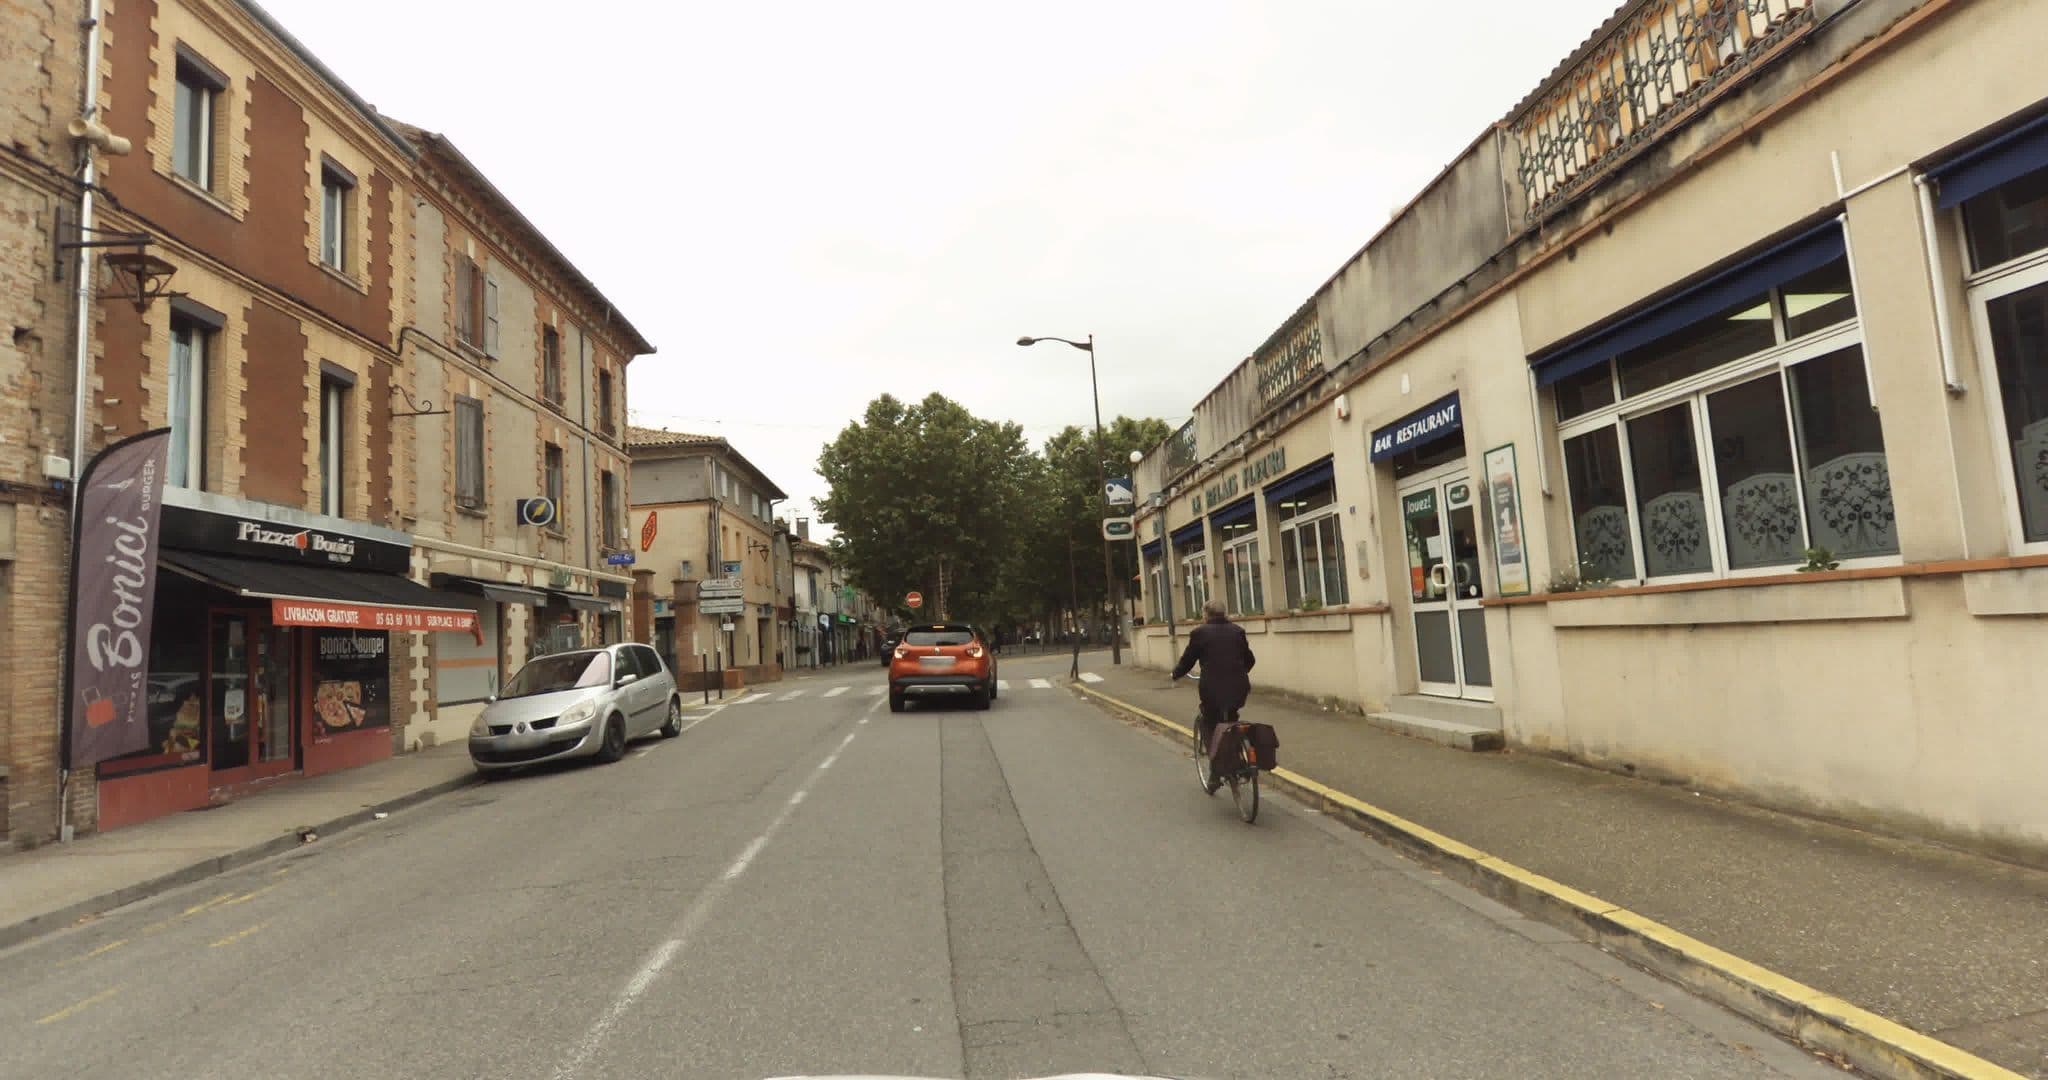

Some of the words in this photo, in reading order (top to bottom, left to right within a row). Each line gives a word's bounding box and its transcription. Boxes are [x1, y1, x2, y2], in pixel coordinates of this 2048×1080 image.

[1374, 434, 1392, 454] BAR
[1396, 404, 1456, 445] RESTAURANT
[141, 459, 155, 511] BURGER
[237, 521, 297, 548] Pizza
[86, 516, 149, 673] Bonici
[283, 606, 325, 622] LIVRAISON
[327, 609, 359, 624] GRATUITE
